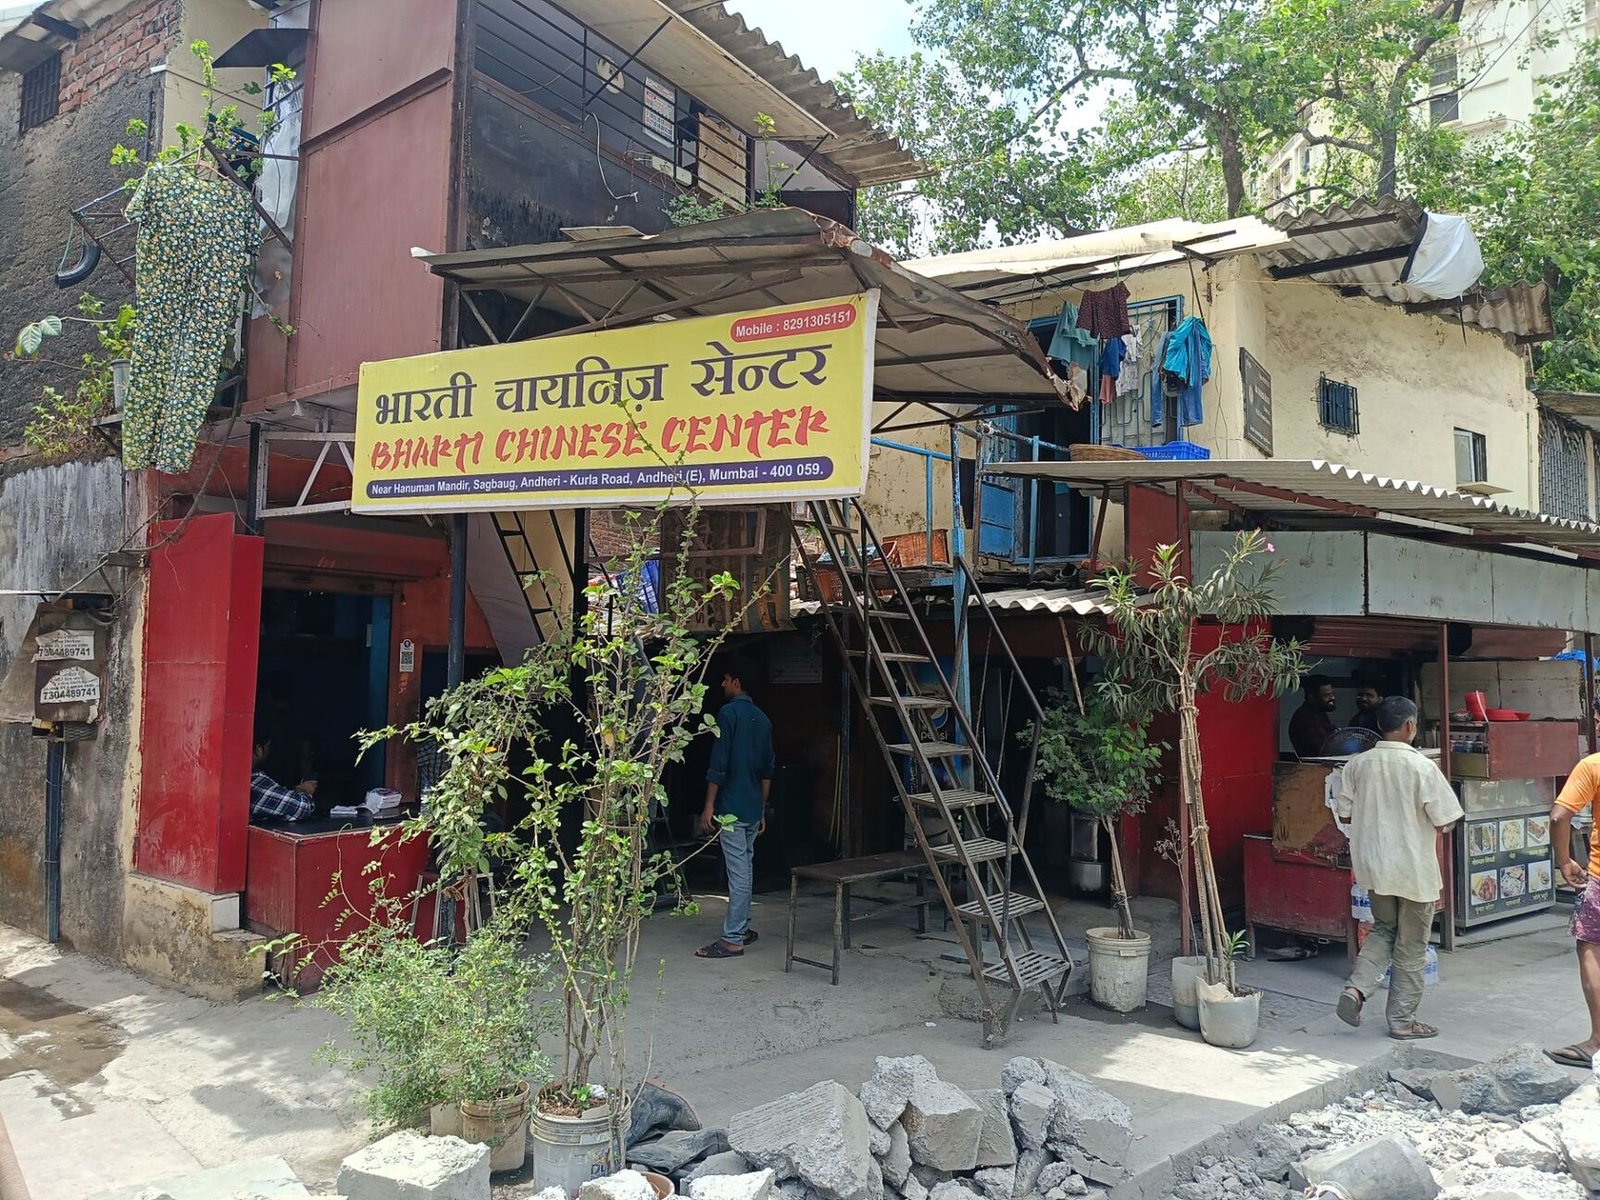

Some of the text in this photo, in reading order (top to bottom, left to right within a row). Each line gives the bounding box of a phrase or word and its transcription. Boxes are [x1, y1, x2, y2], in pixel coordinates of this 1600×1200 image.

[735, 322, 773, 338] Mobile
[783, 310, 851, 331] 8291305151
[375, 341, 833, 424] भारती चायनिज़ सेन्टर
[370, 405, 830, 474] BHARTI CHINESE CENTER
[371, 484, 392, 495] Near
[394, 482, 435, 494] Hanuman
[438, 480, 470, 492] Mandir,
[473, 478, 519, 492] Sagbaug,
[520, 475, 561, 488] Andheri
[570, 474, 598, 486] Kurla
[601, 472, 633, 485] Road,
[637, 470, 682, 484] Andheri
[685, 468, 705, 484] (E),
[709, 467, 758, 481] Mumbai
[769, 464, 792, 478] 400
[797, 462, 824, 476] 059.
[39, 648, 91, 657] 7304489741
[43, 688, 97, 700] 7304489741
[920, 731, 948, 741] pesi
